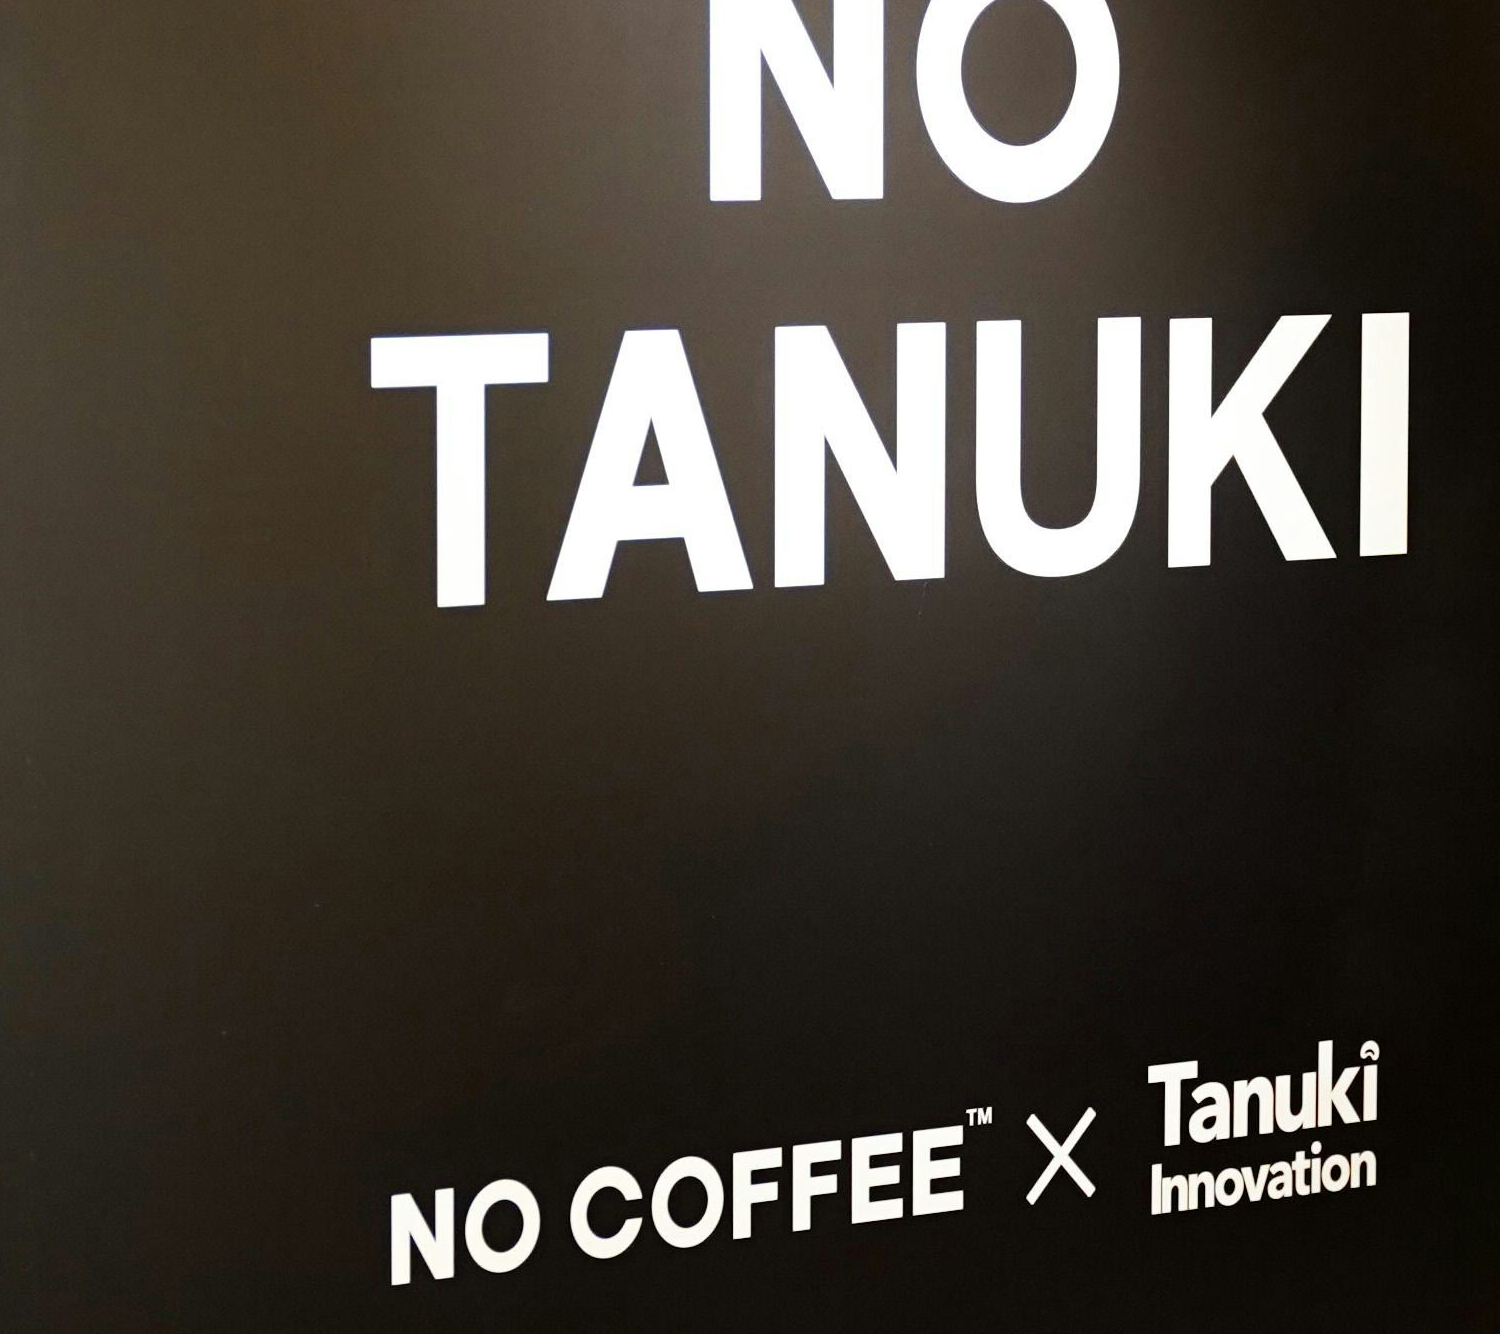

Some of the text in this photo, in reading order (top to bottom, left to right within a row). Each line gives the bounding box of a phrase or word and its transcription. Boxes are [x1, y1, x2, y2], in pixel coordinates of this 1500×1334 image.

[370, 312, 1410, 608] TANUKI
[1147, 1039, 1380, 1148] Tanuki
[390, 1178, 541, 1286] NO
[1150, 1142, 1377, 1216] Innovation
